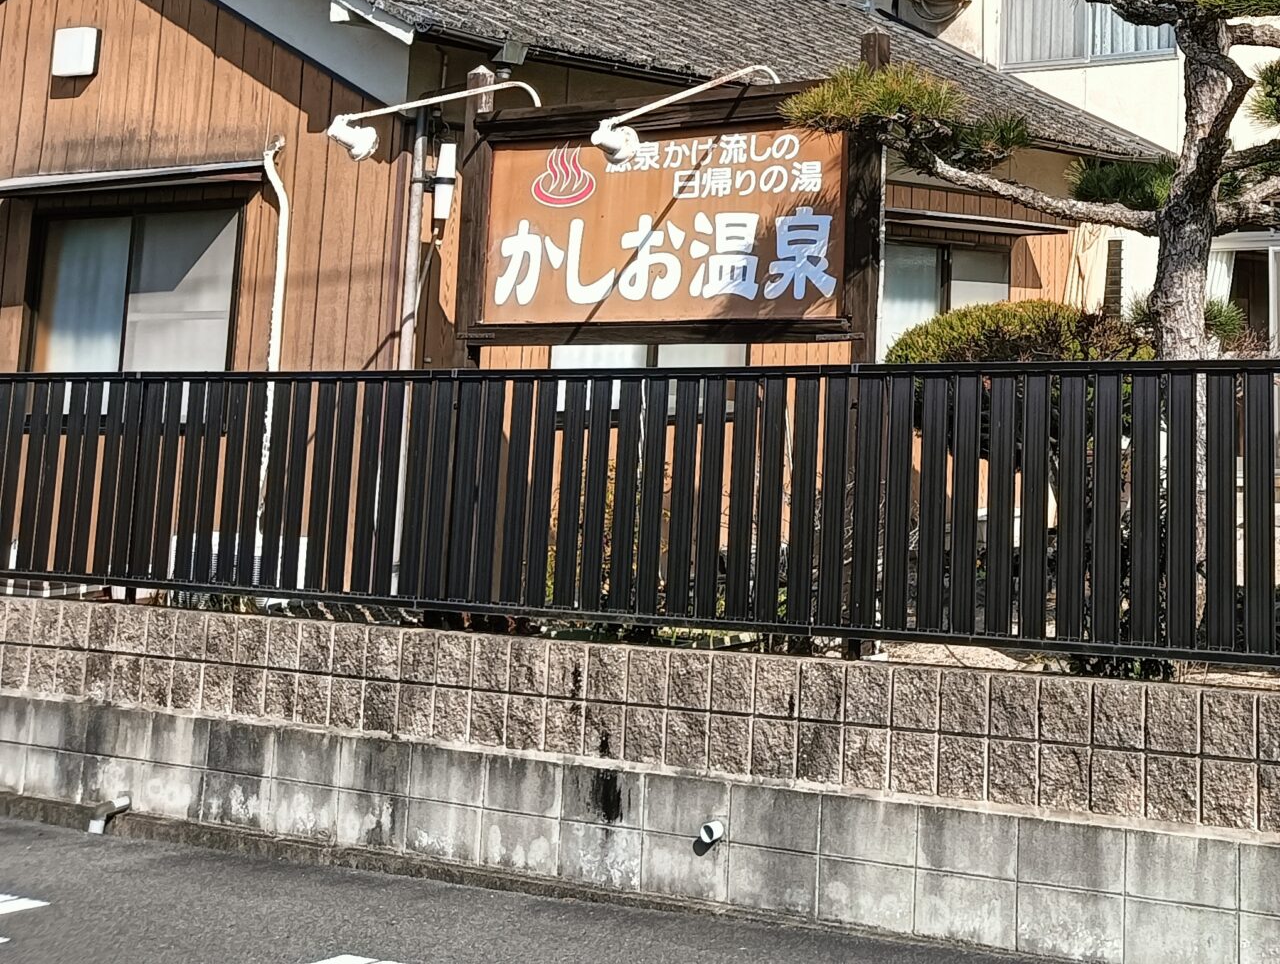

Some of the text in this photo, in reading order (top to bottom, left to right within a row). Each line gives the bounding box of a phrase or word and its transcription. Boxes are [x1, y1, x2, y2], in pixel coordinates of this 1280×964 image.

[673, 161, 822, 199] 日帰りの湯
[494, 207, 837, 306] かしお温泉
